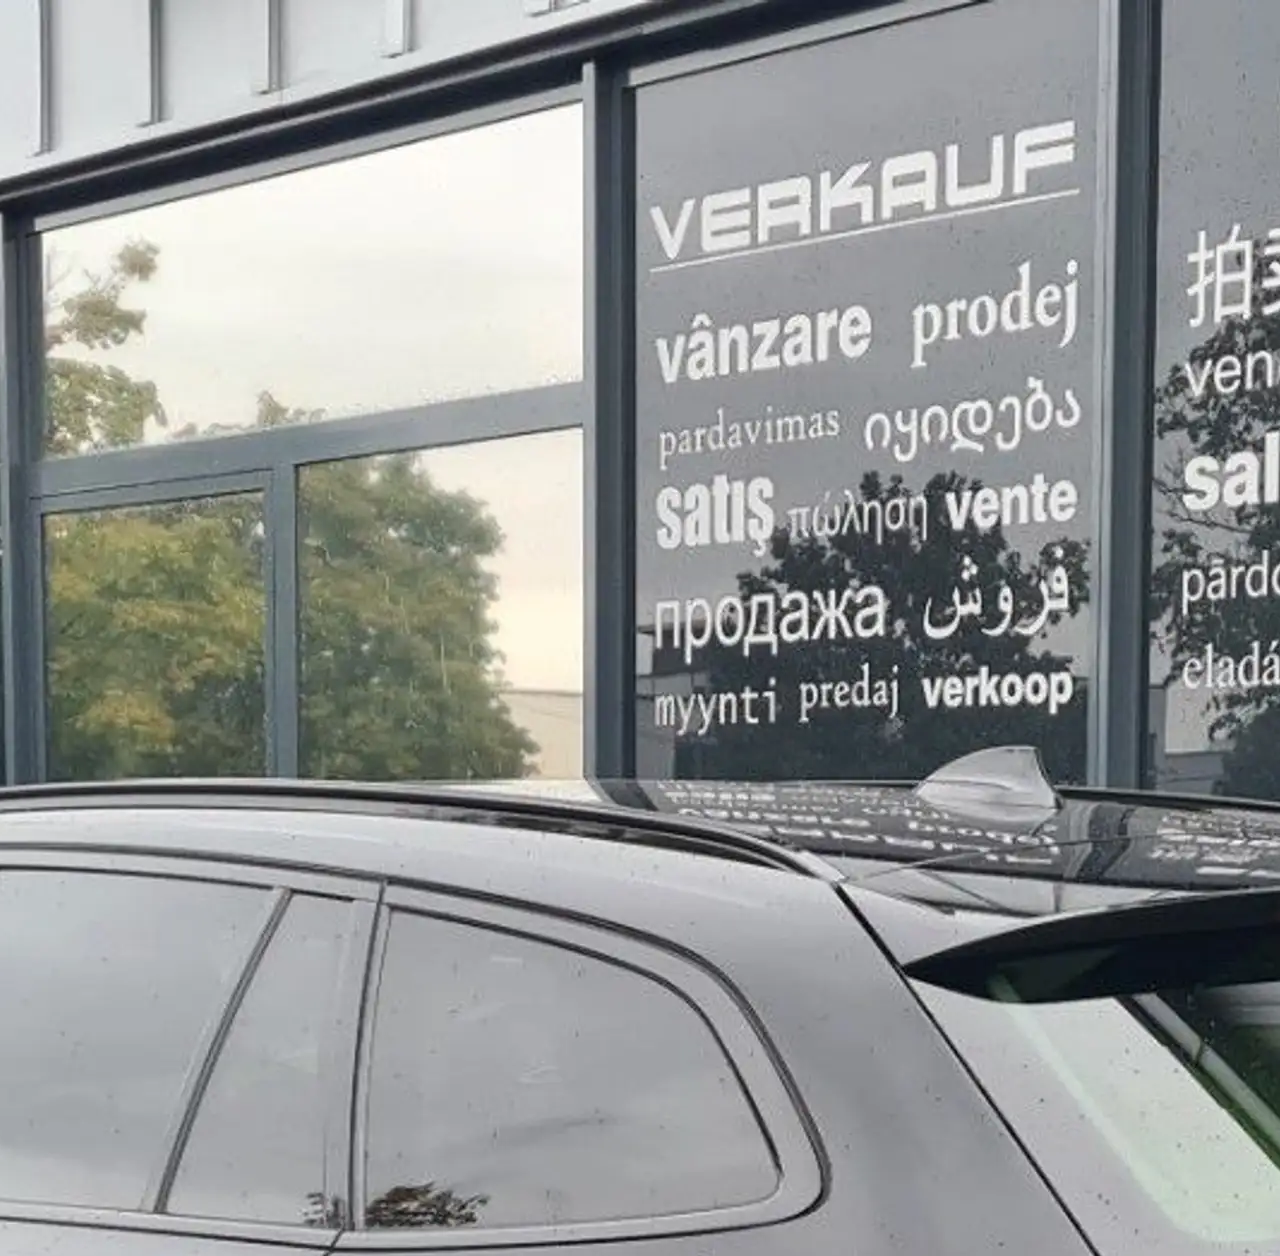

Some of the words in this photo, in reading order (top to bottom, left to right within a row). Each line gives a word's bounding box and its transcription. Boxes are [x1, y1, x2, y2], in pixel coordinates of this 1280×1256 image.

[650, 121, 1076, 259] VERKAUF
[656, 305, 872, 384] vânzare
[911, 259, 1080, 368] prodej
[659, 406, 840, 471] pardavimas
[865, 376, 1081, 462] იყიდება
[656, 474, 774, 557] satış
[787, 489, 928, 543] πώληση
[945, 473, 1078, 531] vente
[656, 583, 887, 664] продажа
[656, 679, 776, 737] myynti
[799, 663, 900, 723] predaj
[923, 667, 1073, 716] verkoop
